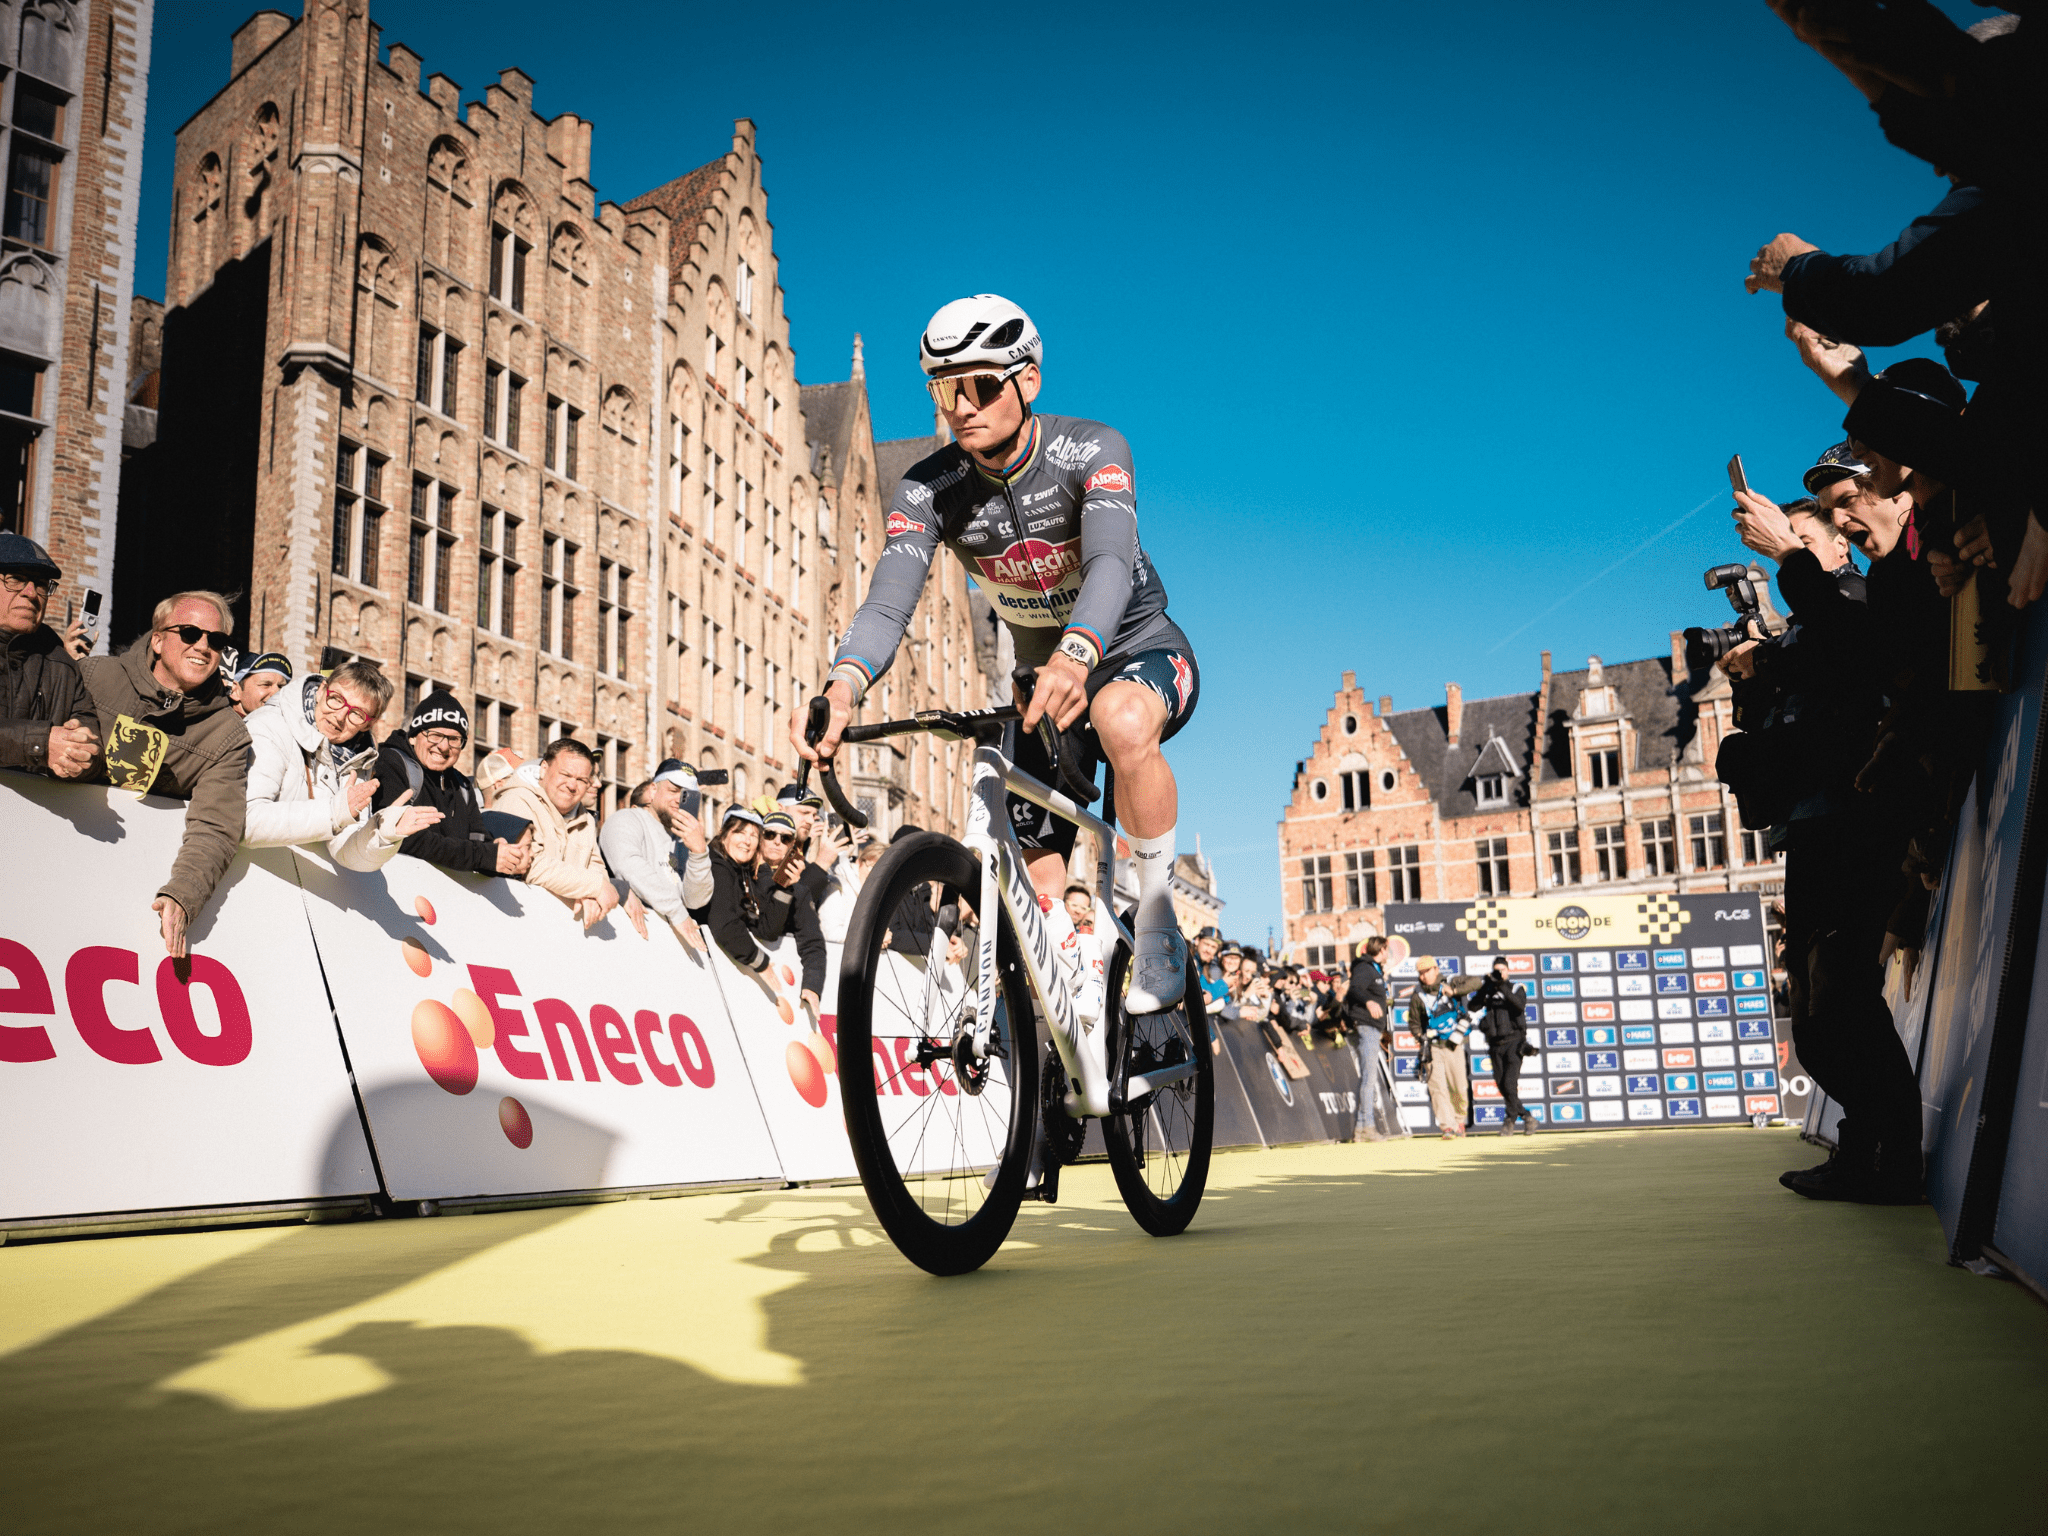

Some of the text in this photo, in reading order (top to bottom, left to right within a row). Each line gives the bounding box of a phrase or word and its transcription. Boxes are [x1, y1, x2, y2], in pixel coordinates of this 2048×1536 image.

[1034, 484, 1059, 501] ZWIFT
[1024, 500, 1062, 517] CANYON
[994, 548, 1079, 581] Alpecin
[1394, 923, 1415, 933] UCI
[1535, 919, 1553, 928] DE
[1594, 916, 1611, 927] DE
[977, 940, 993, 1034] CANYON
[1550, 982, 1571, 992] MAES
[1743, 1000, 1765, 1009] MAES
[466, 963, 715, 1089] Eneco
